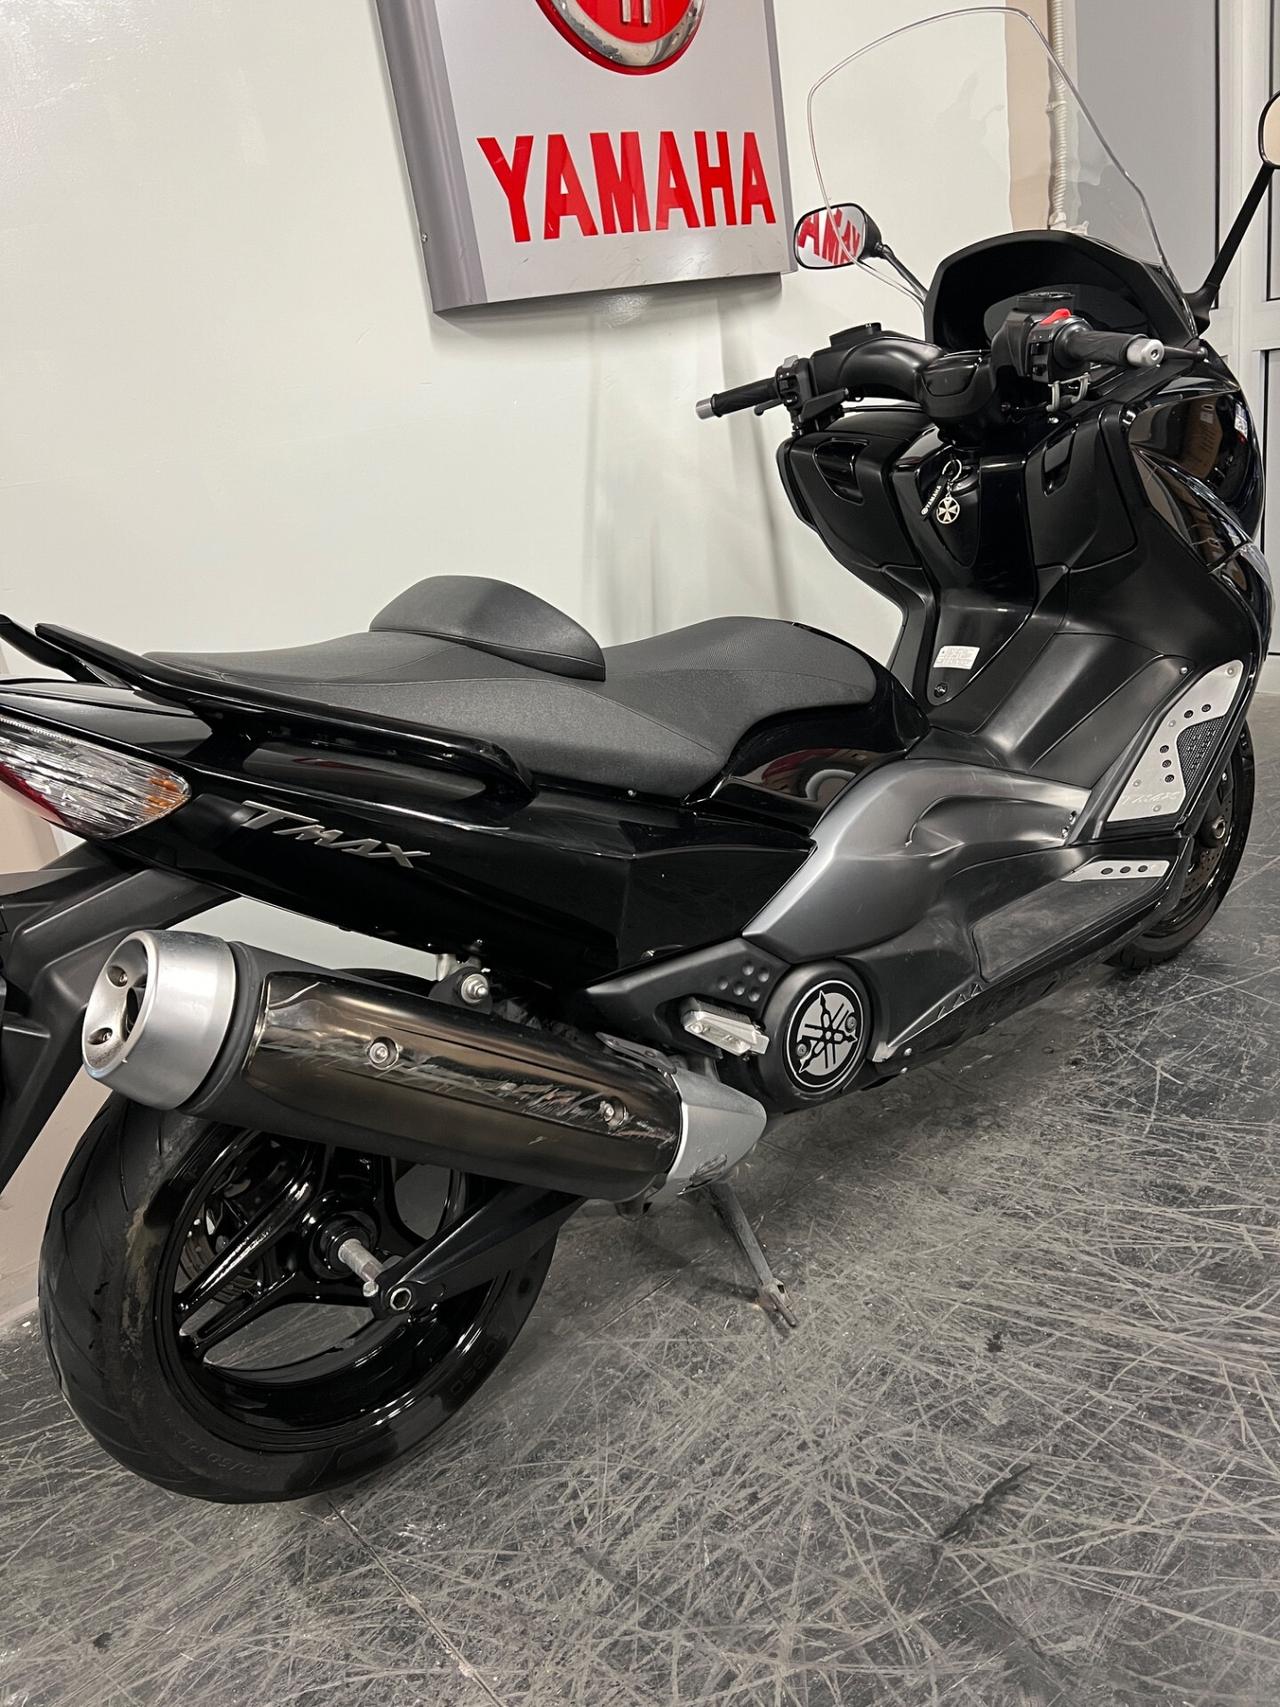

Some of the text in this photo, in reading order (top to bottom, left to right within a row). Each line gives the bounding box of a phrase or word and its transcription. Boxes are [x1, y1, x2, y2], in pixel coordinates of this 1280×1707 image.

[476, 131, 776, 243] YAMAHA
[925, 485, 942, 508] YAMAHA
[239, 800, 431, 868] TMAX
